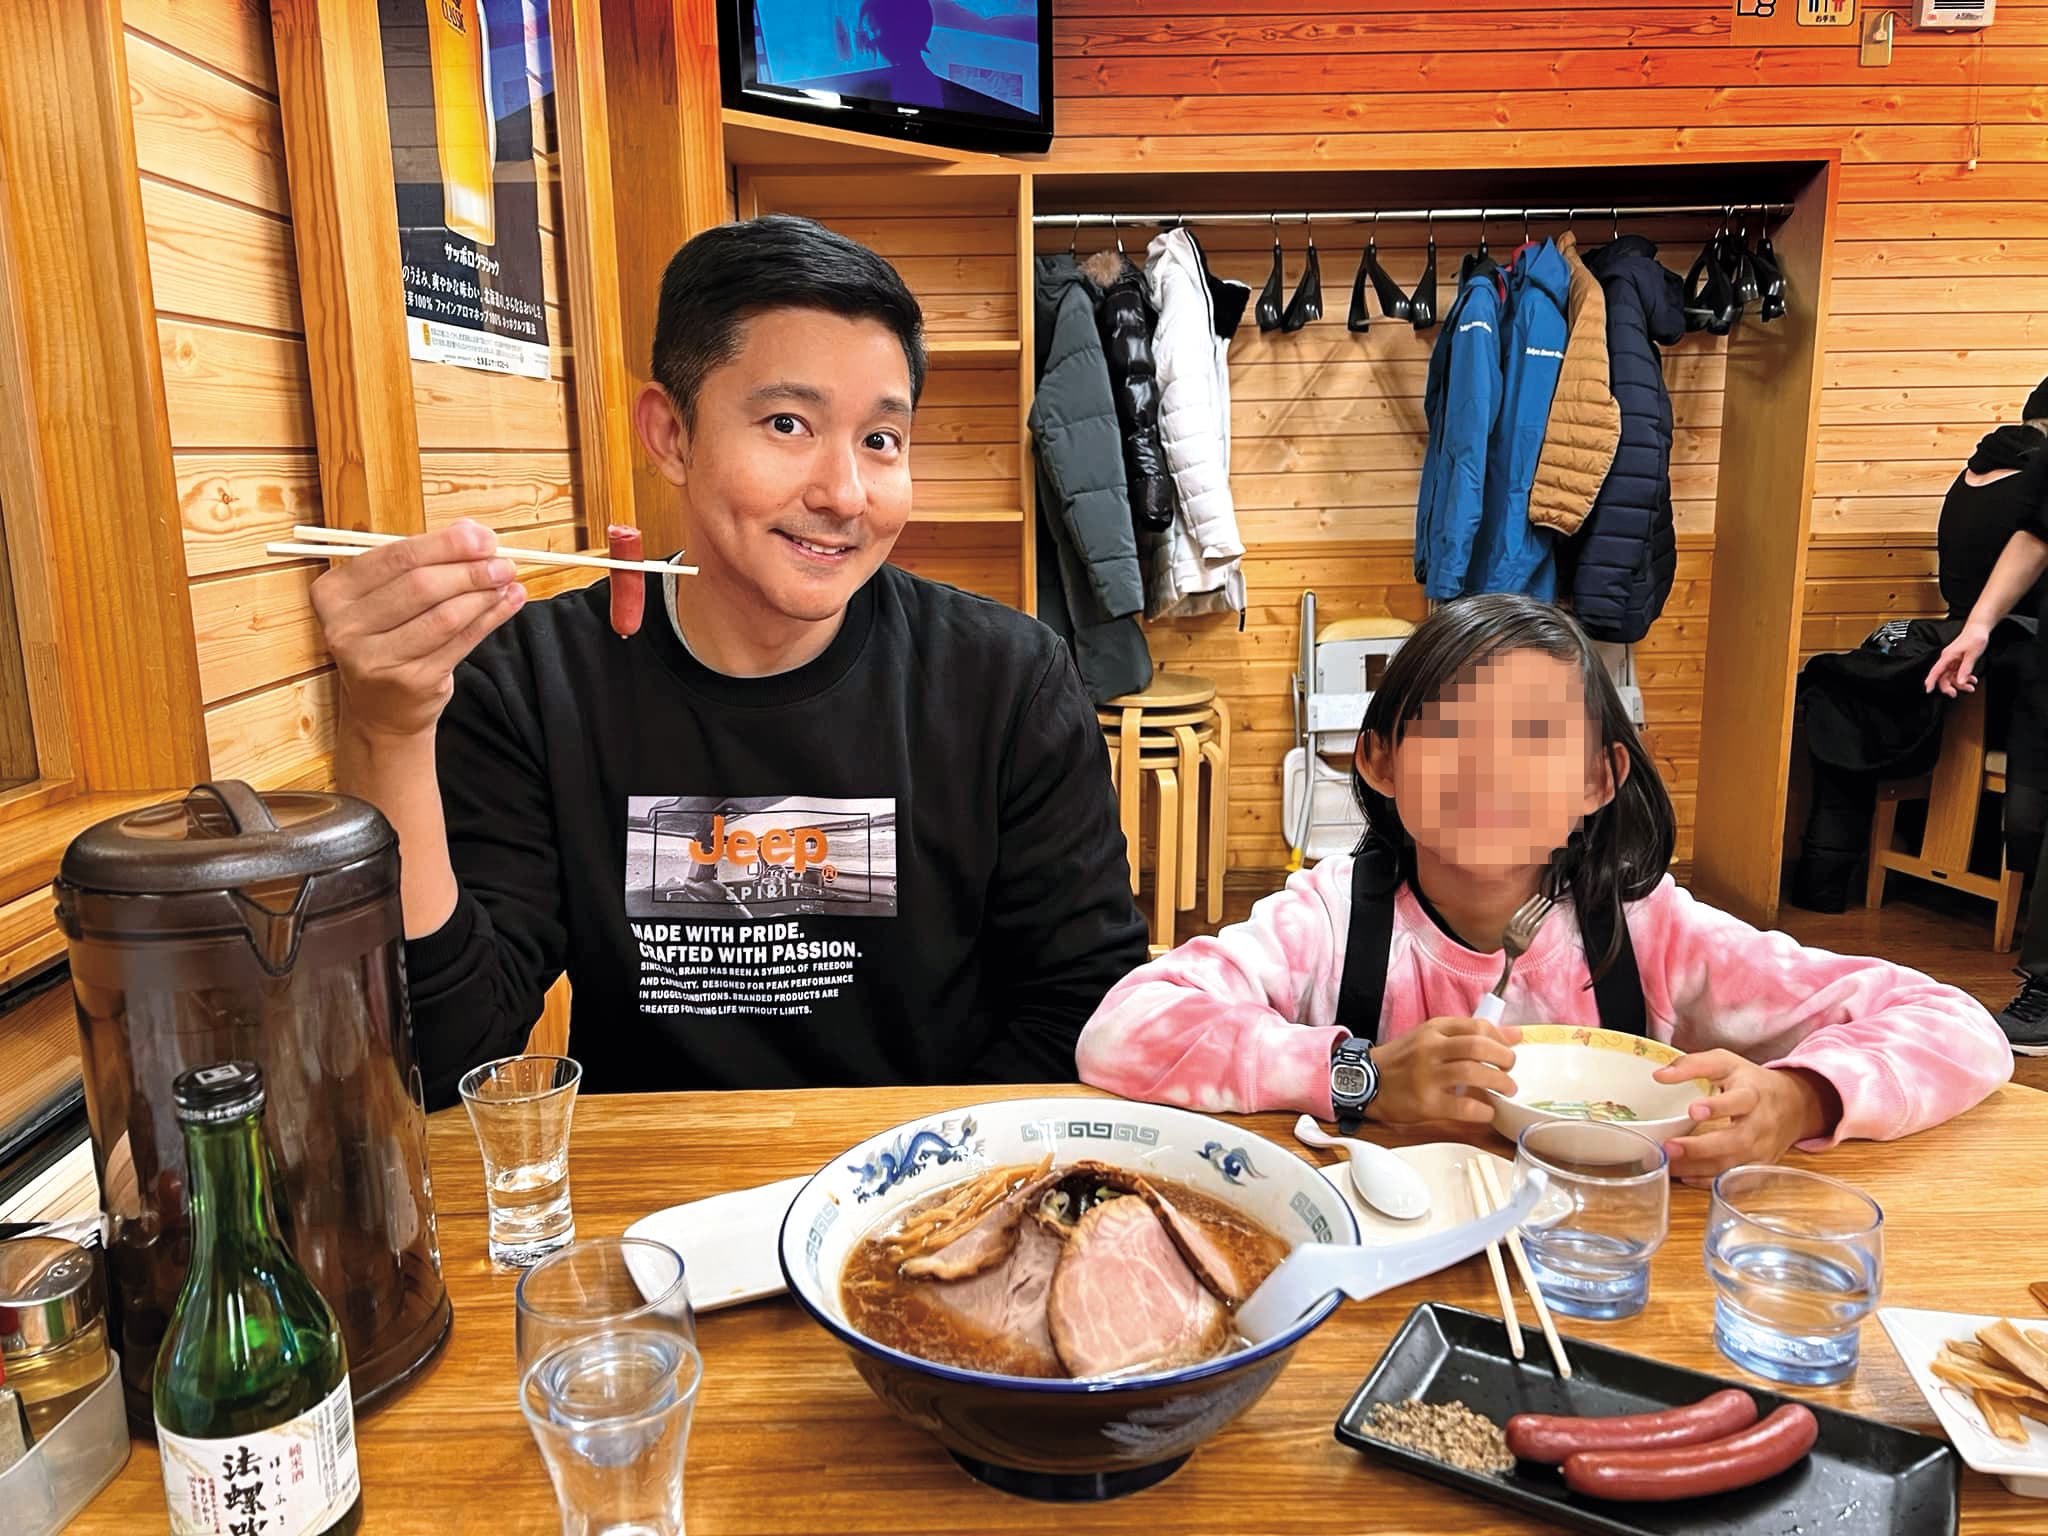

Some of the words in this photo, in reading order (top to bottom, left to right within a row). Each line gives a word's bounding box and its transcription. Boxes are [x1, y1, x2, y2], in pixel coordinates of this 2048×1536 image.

[445, 242, 500, 276] サッポロクラシック
[689, 815, 828, 873] Jeep
[725, 882, 802, 900] SPIRIT
[631, 923, 681, 942] MADE
[685, 925, 734, 943] WITH
[740, 922, 805, 943] PRIDE.
[639, 941, 713, 963] CRAFTED
[718, 946, 767, 963] WITH
[773, 941, 863, 962] PASSION.
[679, 966, 708, 976] BRAND
[710, 967, 727, 976] HAS
[729, 967, 751, 977] BEEN
[753, 968, 760, 977] A
[762, 964, 796, 977] SYMBOL
[797, 963, 809, 973] OF
[813, 961, 854, 973] FREEDOM
[640, 977, 659, 986] AND
[702, 980, 745, 990] DESIGNED
[747, 982, 764, 990] FOR
[766, 980, 790, 990] PEAK
[791, 974, 854, 988] PERFORMANCE
[639, 990, 649, 999] IN
[733, 992, 772, 1002] BRANDED
[774, 990, 820, 1002] PRODUCTS
[822, 988, 839, 999] ARE
[640, 1004, 680, 1014] CREATED
[718, 1005, 737, 1015] LIFE
[738, 1005, 777, 1016] WITHOUT
[780, 1005, 813, 1016] LIMITS.
[288, 1442, 304, 1485] 純米酒
